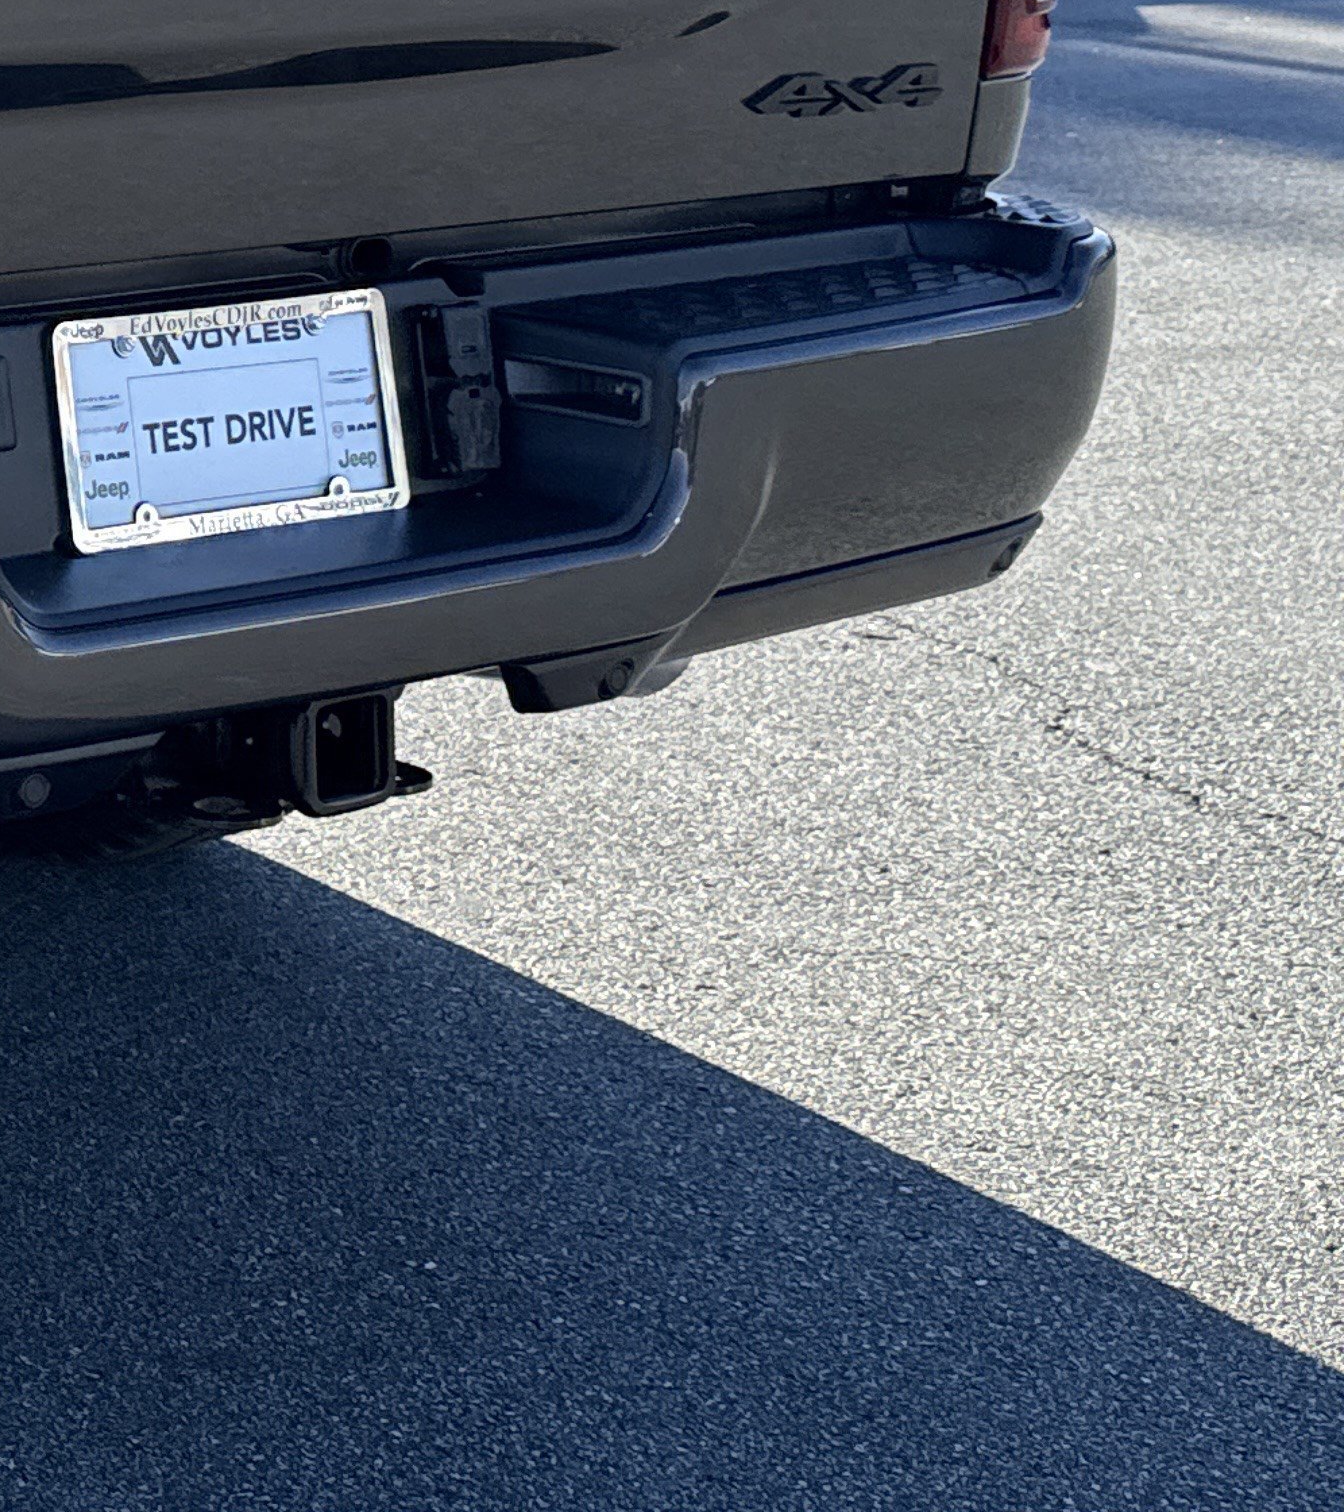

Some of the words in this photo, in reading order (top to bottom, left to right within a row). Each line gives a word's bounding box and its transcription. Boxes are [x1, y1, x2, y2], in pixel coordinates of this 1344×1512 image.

[69, 323, 105, 339] Jeep
[180, 318, 302, 351] VOYLES
[142, 416, 215, 455] TEST
[224, 405, 317, 445] DRIVE
[346, 421, 377, 432] RAM
[95, 451, 130, 462] RAM
[338, 448, 378, 469] Jeep
[85, 479, 130, 500] Jeep
[275, 503, 306, 525] GA
